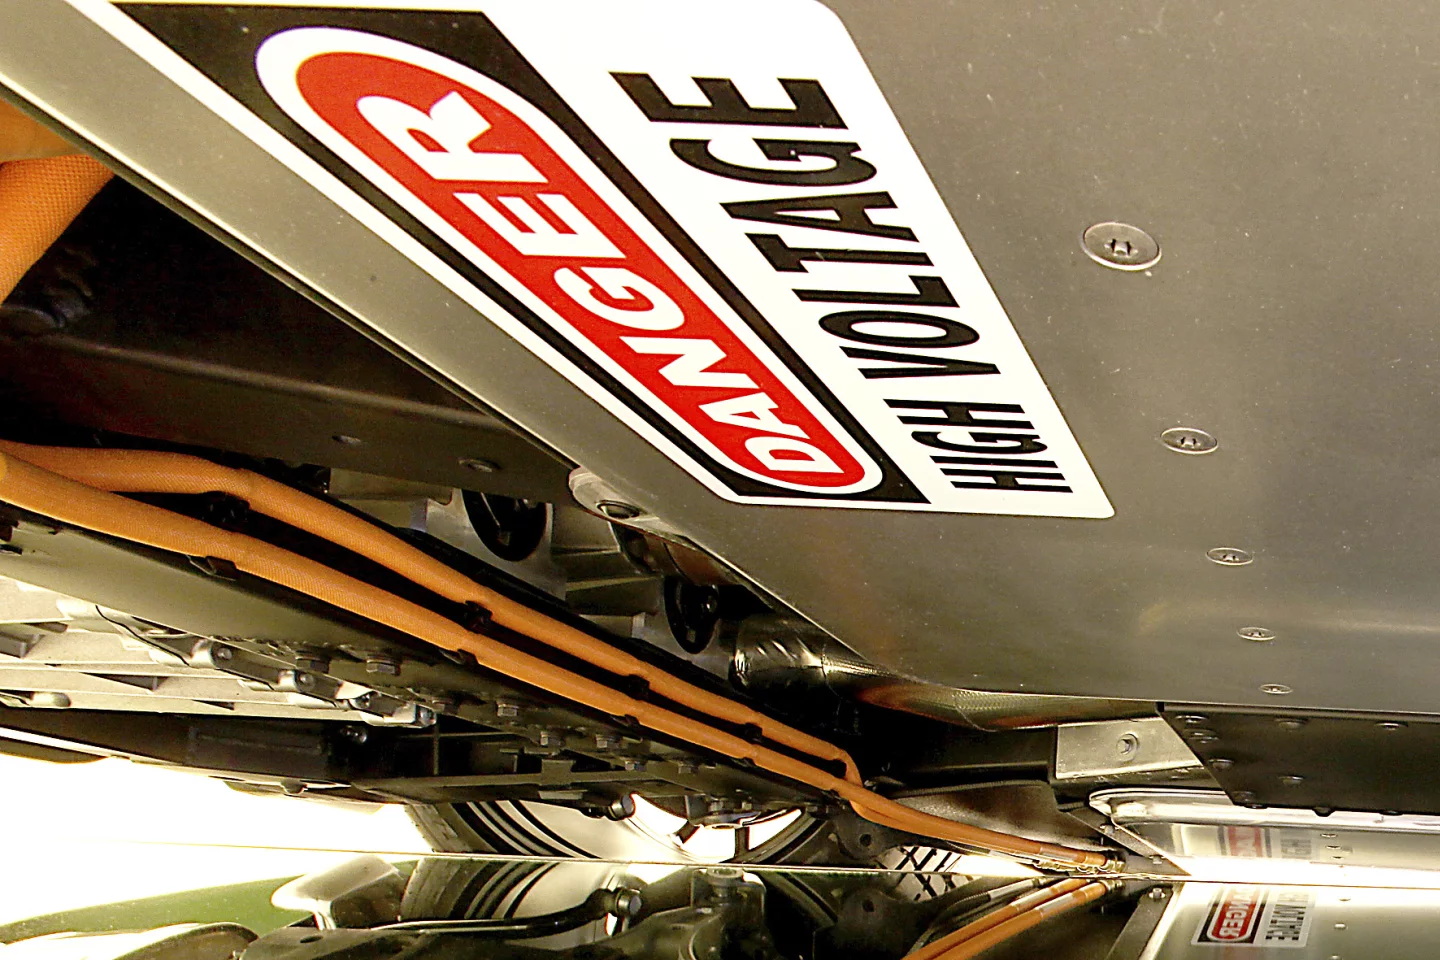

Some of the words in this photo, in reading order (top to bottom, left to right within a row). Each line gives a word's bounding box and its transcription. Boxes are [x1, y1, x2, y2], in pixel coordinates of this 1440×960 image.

[356, 90, 845, 474] DANGER
[607, 70, 1002, 379] VOLTAGE
[882, 398, 1074, 494] HIGH
